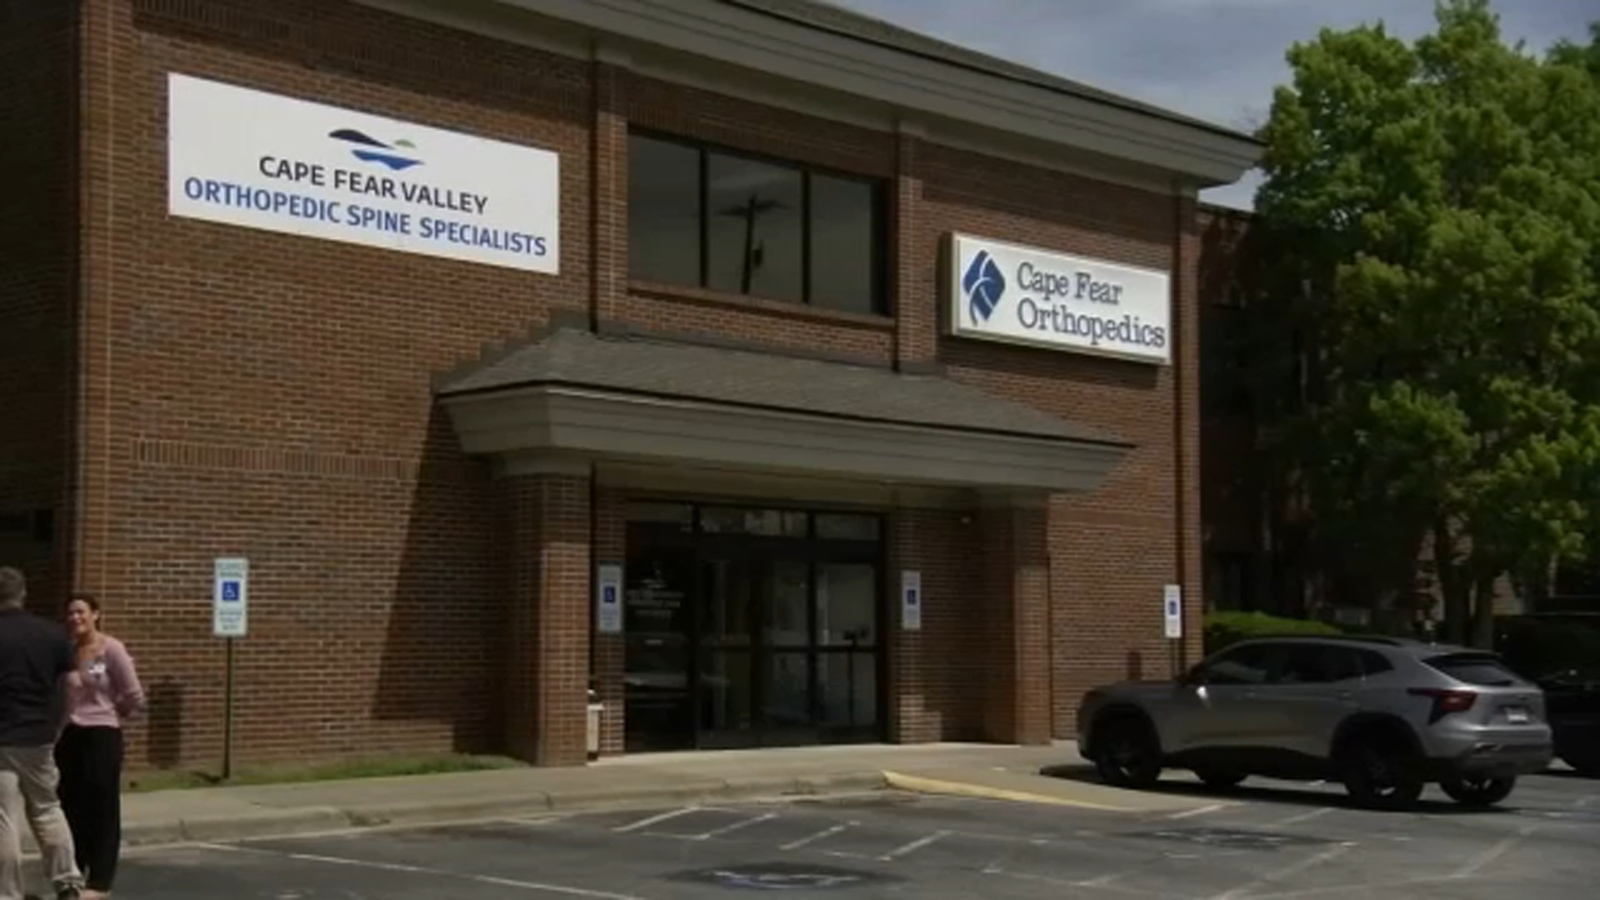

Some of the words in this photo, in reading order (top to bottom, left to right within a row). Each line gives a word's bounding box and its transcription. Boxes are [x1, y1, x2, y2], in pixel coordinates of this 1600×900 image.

[259, 155, 325, 186] CAPE
[334, 169, 397, 199] FEAR
[402, 181, 489, 215] VALLEY
[184, 177, 340, 224] ORTHOPEDIC
[347, 204, 411, 235] SPINE
[419, 217, 547, 257] SPECIALISTS
[1017, 262, 1069, 301] Cape
[1075, 272, 1123, 305] Fear
[1017, 297, 1165, 347] Orthopedics
